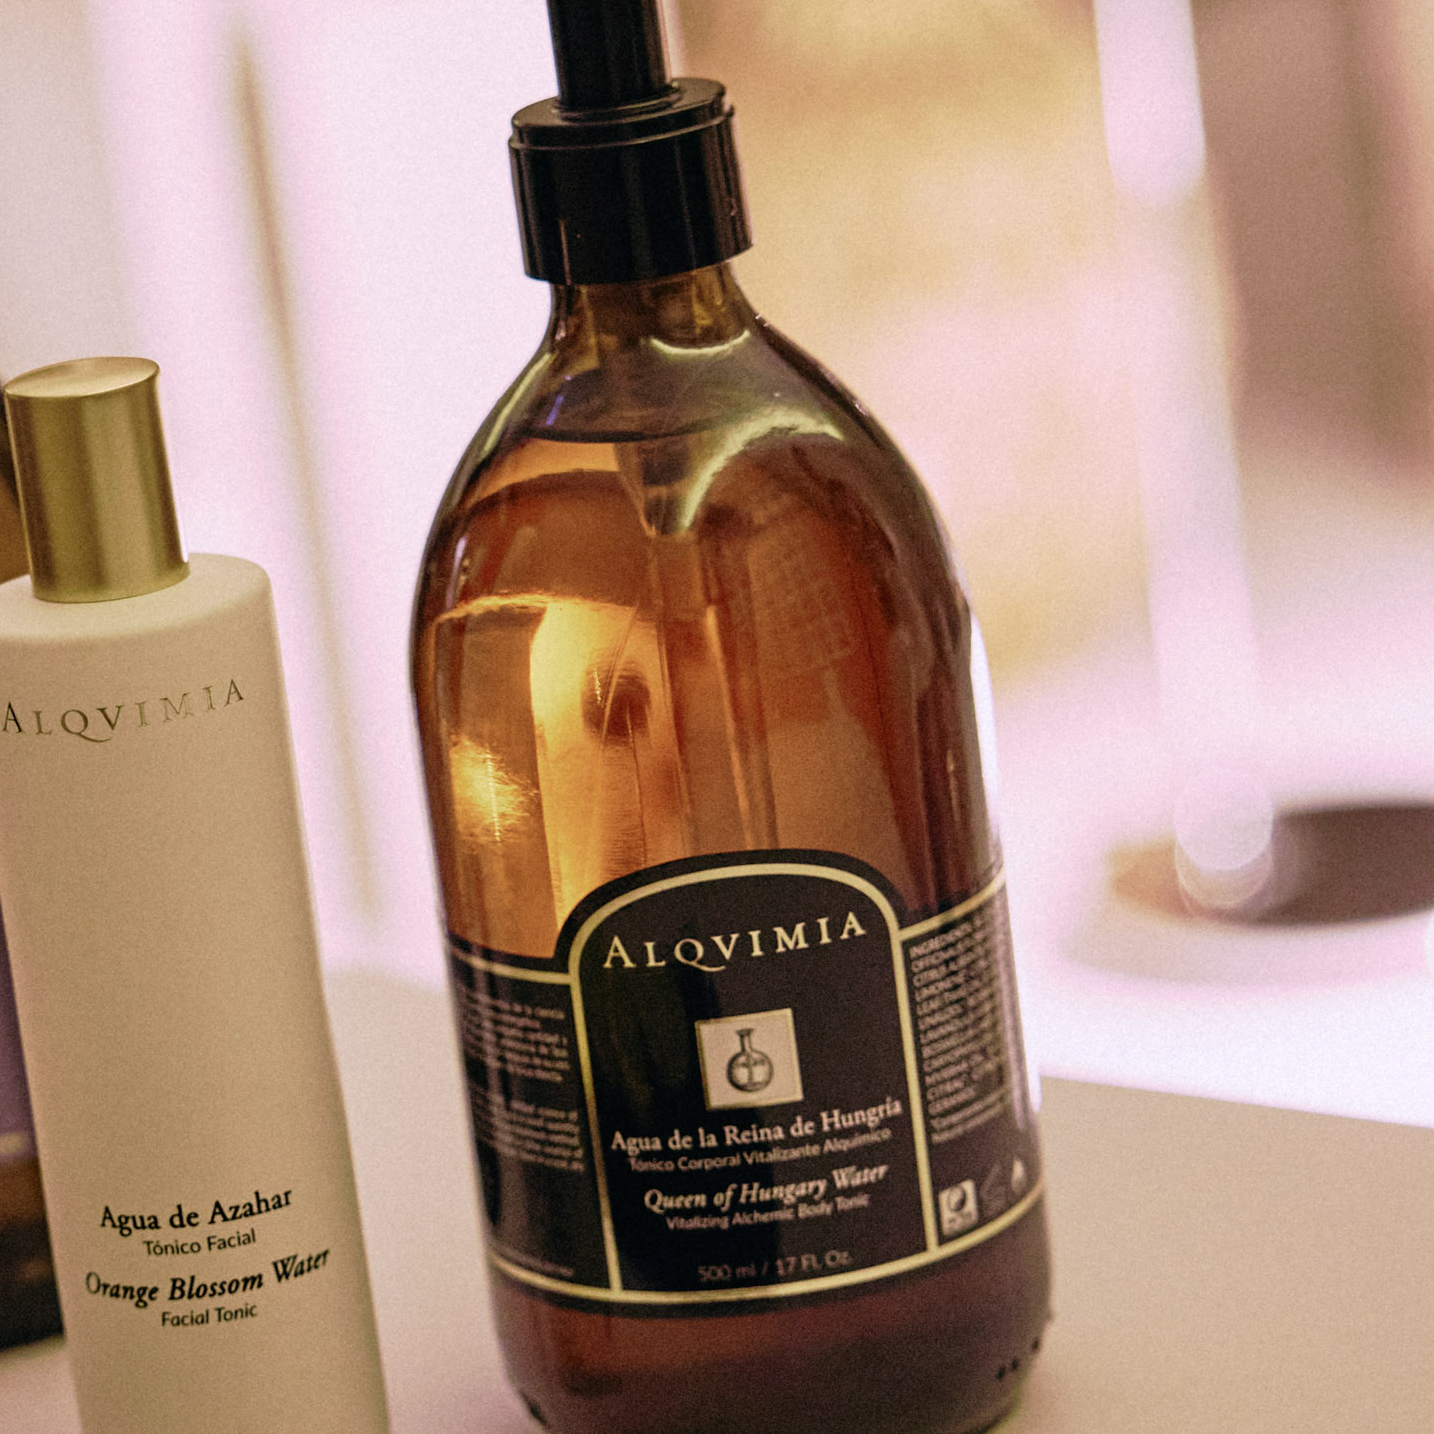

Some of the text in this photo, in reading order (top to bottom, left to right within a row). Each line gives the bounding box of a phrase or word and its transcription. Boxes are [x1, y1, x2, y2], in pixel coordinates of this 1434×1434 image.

[2, 679, 244, 743] ALQVIMIA
[603, 911, 867, 973] ALQVIMIA
[611, 1096, 903, 1156] Agua de la Reina de Hungría
[677, 1152, 741, 1171] Corporal
[743, 1143, 820, 1165] Vitalizante
[100, 1189, 293, 1237] Agua de Azahar
[644, 1164, 889, 1215] Queen of Hungary Water
[666, 1193, 870, 1231] Vitalizing Alchemic Body Tonic
[143, 1228, 257, 1257] Tónico Facial
[85, 1248, 330, 1309] Orange Blossom Water
[697, 1263, 733, 1283] 500
[736, 1261, 756, 1279] ml
[775, 1256, 797, 1277] 17
[161, 1303, 258, 1327] Facial Tonic
